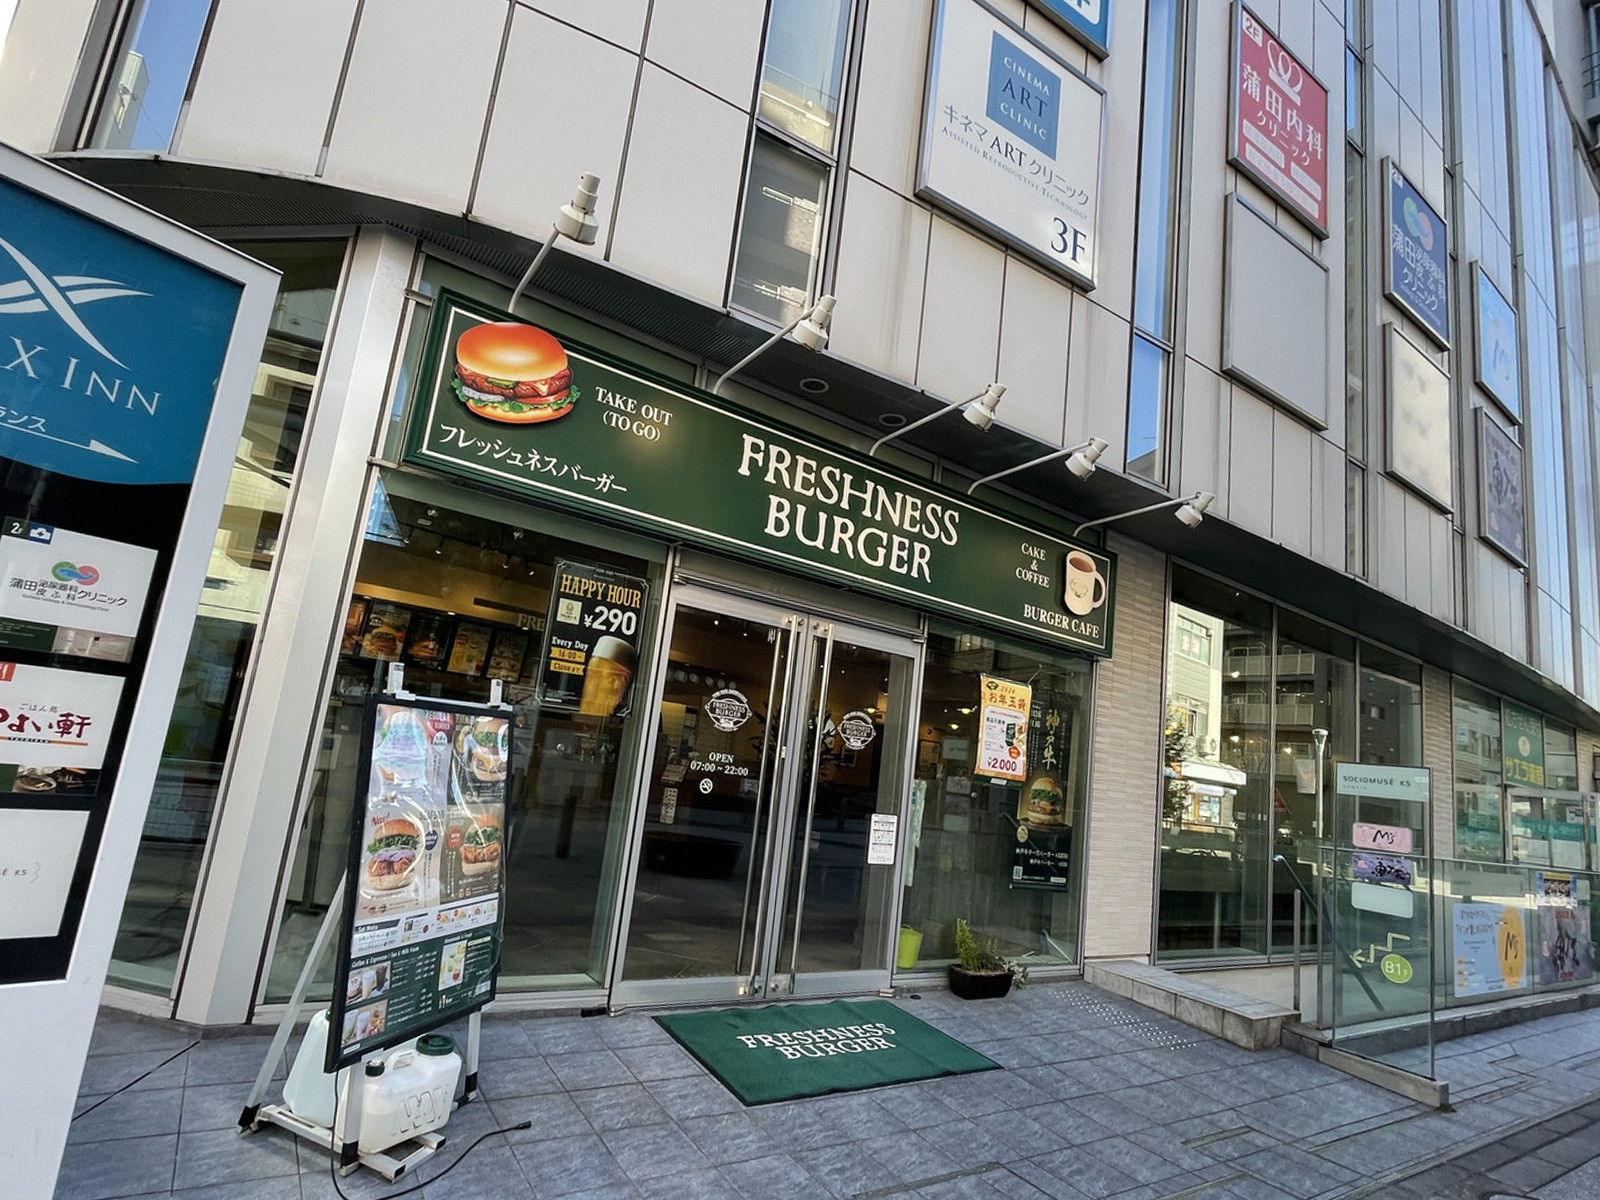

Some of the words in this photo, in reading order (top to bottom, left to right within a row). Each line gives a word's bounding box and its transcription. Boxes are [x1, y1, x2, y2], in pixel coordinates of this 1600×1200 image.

[1003, 56, 1051, 96] CINEMA
[1001, 77, 1047, 119] ART
[1242, 62, 1323, 160] 蒲田内科
[1000, 102, 1047, 141] CLINIC
[1256, 110, 1311, 166] クリニック
[1050, 217, 1088, 265] 3F
[60, 356, 162, 416] INN
[595, 386, 637, 413] TAKE
[641, 403, 673, 427] OUT
[602, 409, 632, 432] (TO
[632, 421, 662, 442] GO)
[439, 423, 628, 494] フレッシュネスバーガー
[737, 433, 960, 546] FRESHNESS
[764, 494, 932, 584] BURGER
[1020, 542, 1047, 561] CAKE
[1015, 567, 1051, 588] COFFEE
[1030, 559, 1039, 571] &
[559, 573, 607, 601] HAPPY
[606, 584, 642, 609] HOUR
[583, 605, 638, 636] ¥290
[1023, 604, 1070, 630] BURGER
[1071, 619, 1100, 639] CAFE
[551, 636, 573, 649] Every
[574, 641, 589, 651] Day
[690, 760, 716, 773] 07:00
[724, 765, 749, 777] 22:00
[708, 752, 734, 764] OPEN
[1372, 829, 1396, 845] M's
[736, 1022, 897, 1049] FRESHNESS
[775, 1036, 897, 1060] BURGER
